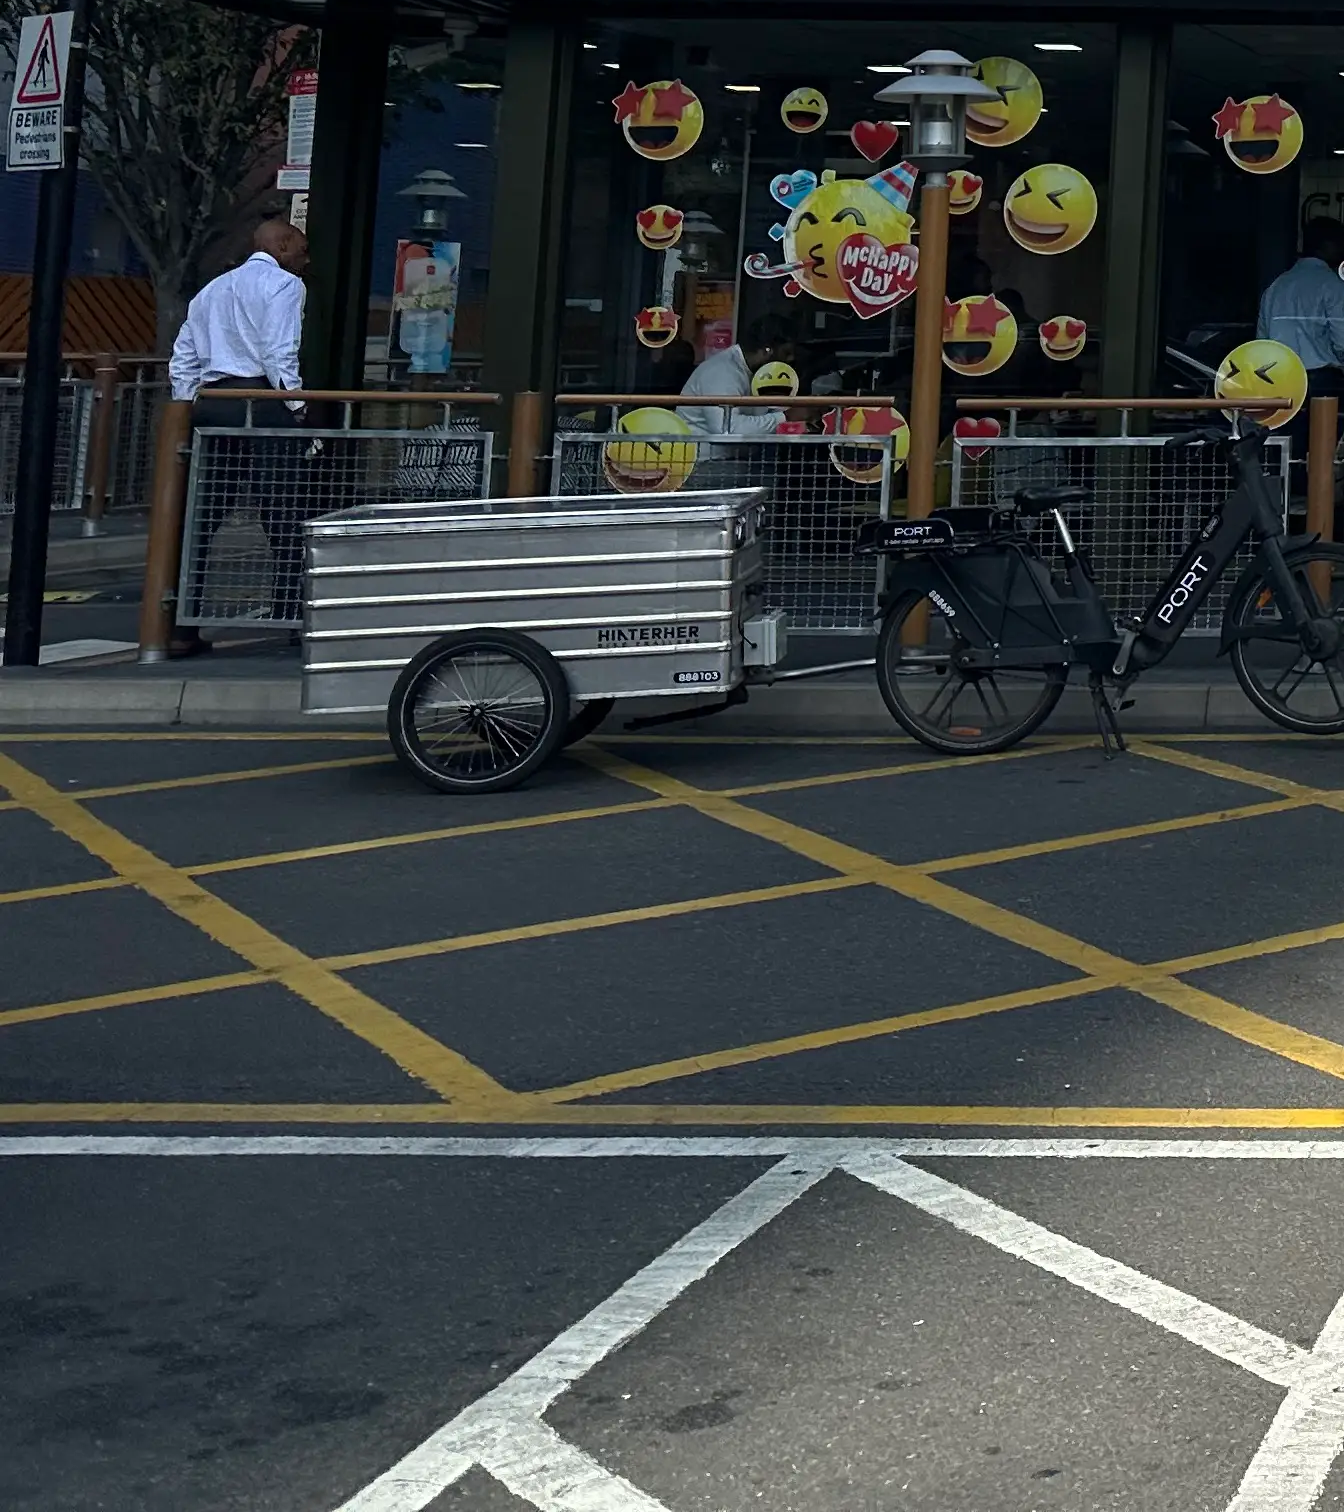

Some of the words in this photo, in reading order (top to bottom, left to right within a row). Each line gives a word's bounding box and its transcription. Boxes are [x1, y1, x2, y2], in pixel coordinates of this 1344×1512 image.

[15, 110, 57, 128] BEWARE
[19, 148, 50, 161] crossing
[842, 245, 918, 281] McHappy
[860, 267, 893, 294] Day
[894, 526, 932, 536] PORT
[1157, 555, 1208, 624] PORT
[678, 671, 719, 682] 888103
